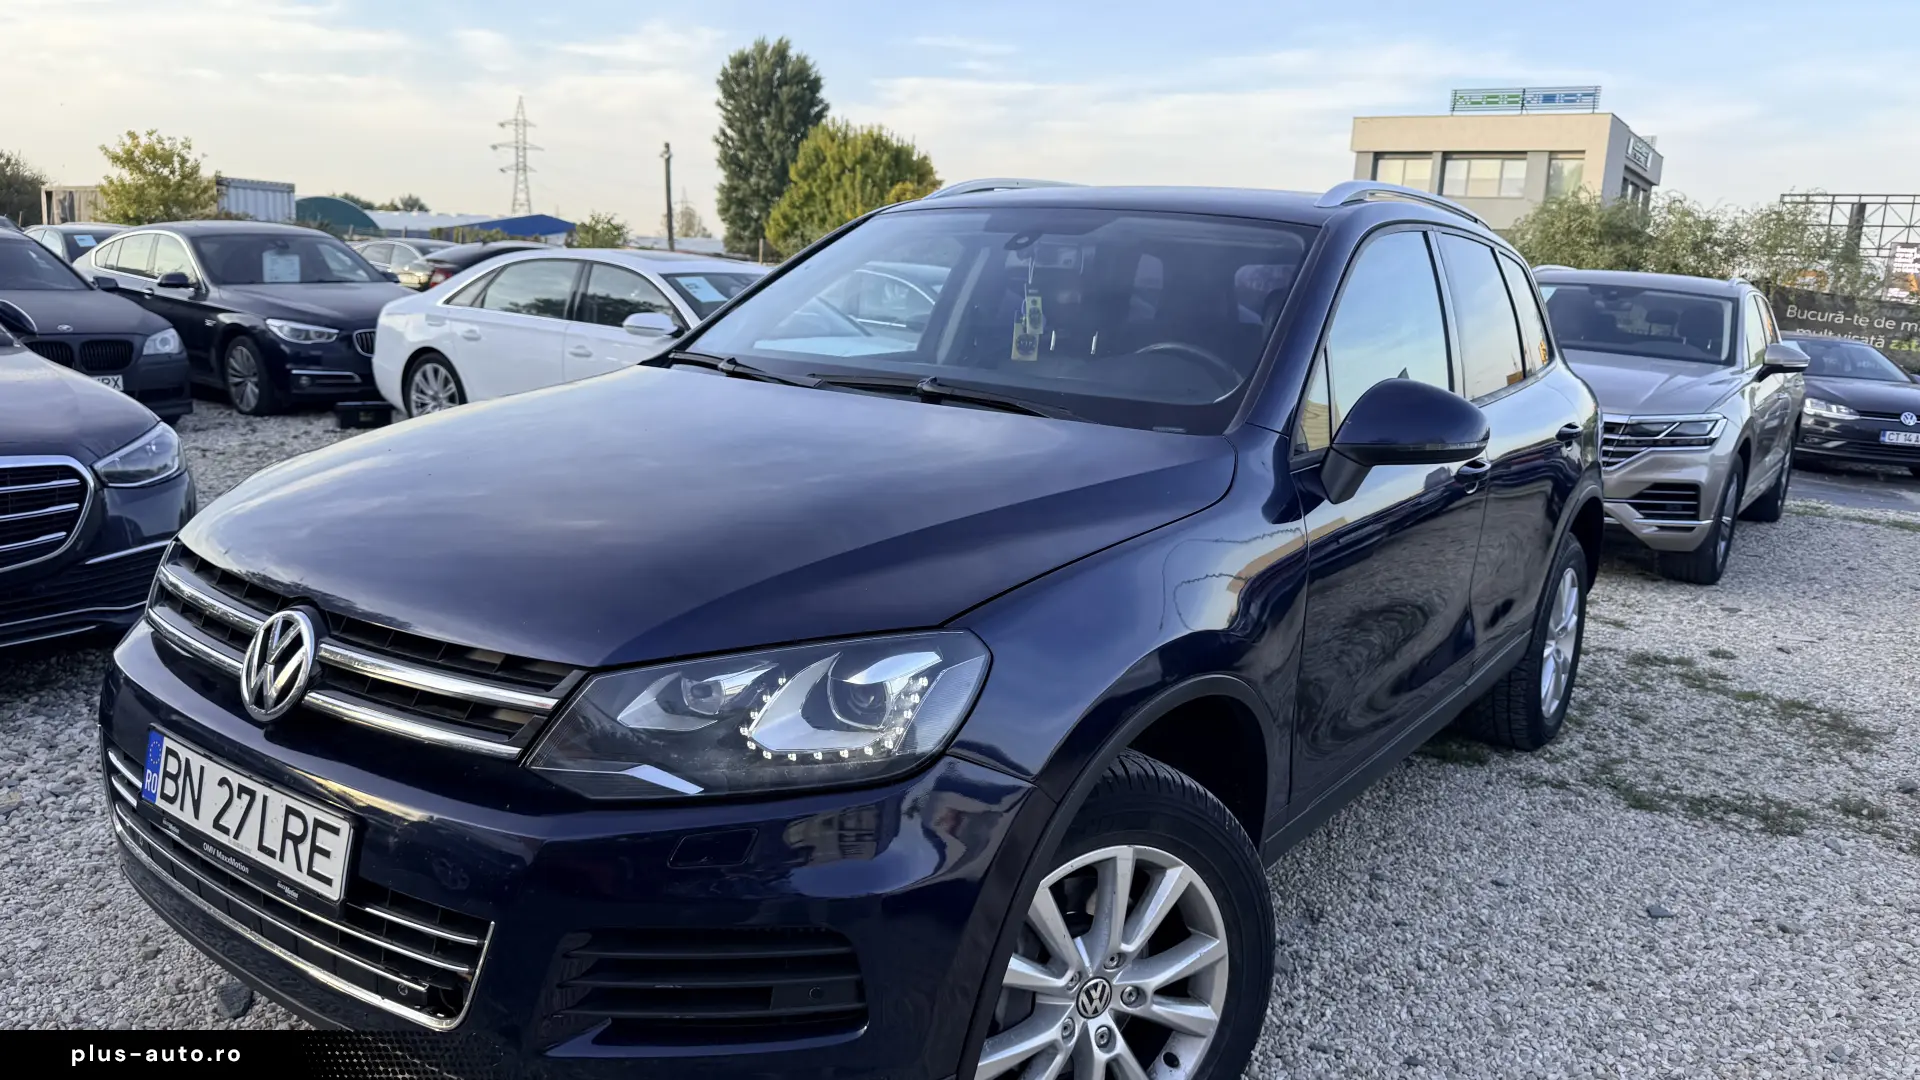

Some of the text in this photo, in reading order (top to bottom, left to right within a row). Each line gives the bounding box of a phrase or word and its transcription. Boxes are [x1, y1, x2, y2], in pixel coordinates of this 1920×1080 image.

[1786, 304, 1920, 333] Bucură-te de m
[144, 769, 159, 794] RO
[160, 745, 205, 821] BN
